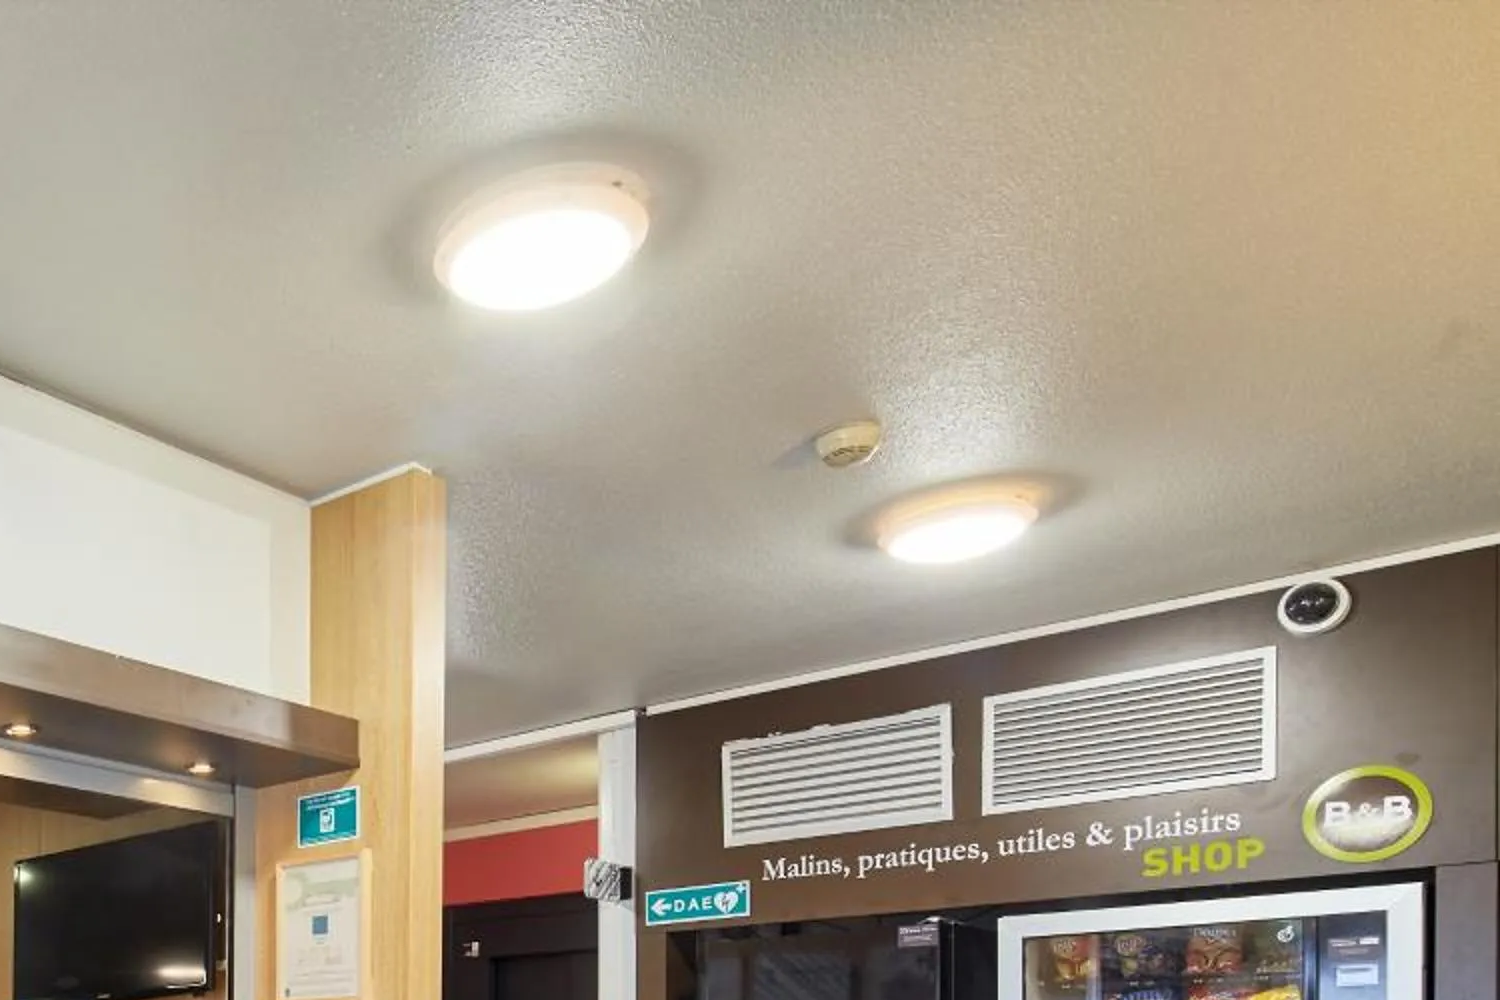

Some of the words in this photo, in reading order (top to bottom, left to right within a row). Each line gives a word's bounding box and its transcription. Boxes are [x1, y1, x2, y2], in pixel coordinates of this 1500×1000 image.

[1323, 795, 1414, 829] B&B
[761, 854, 851, 881] Malins,
[856, 842, 989, 879] pratiques,
[997, 823, 1076, 856] utiles
[1085, 820, 1114, 848] &
[1124, 810, 1241, 851] plaisirs
[1141, 838, 1266, 879] SHOP
[673, 895, 713, 913] DAE
